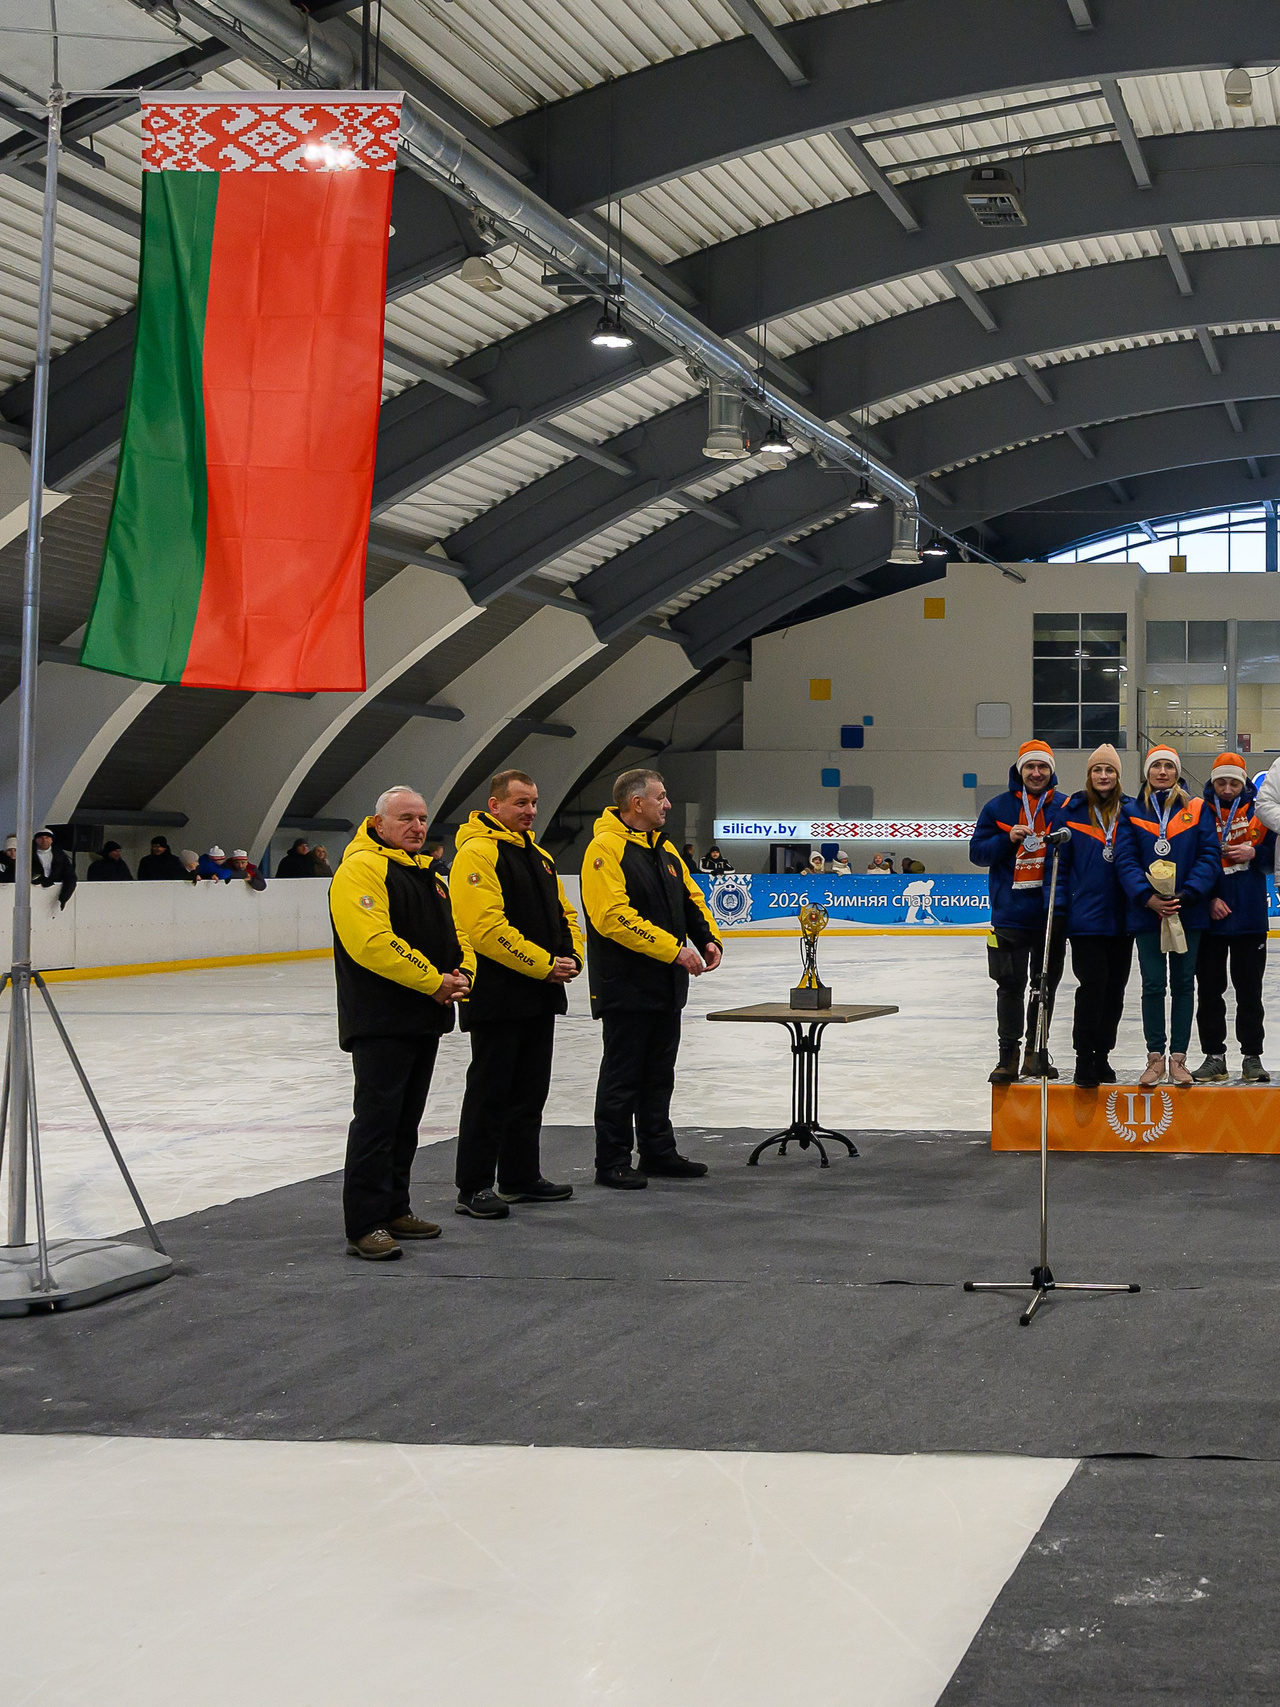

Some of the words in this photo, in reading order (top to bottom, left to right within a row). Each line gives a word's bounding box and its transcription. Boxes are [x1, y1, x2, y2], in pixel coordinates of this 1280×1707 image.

[722, 823, 797, 837] silichy.by
[768, 892, 809, 908] 2026
[823, 891, 888, 908] Зимняя
[617, 914, 657, 944] BELARUS
[389, 939, 429, 973] BELARUS
[497, 935, 536, 967] BELARUS
[1123, 1093, 1155, 1125] II
